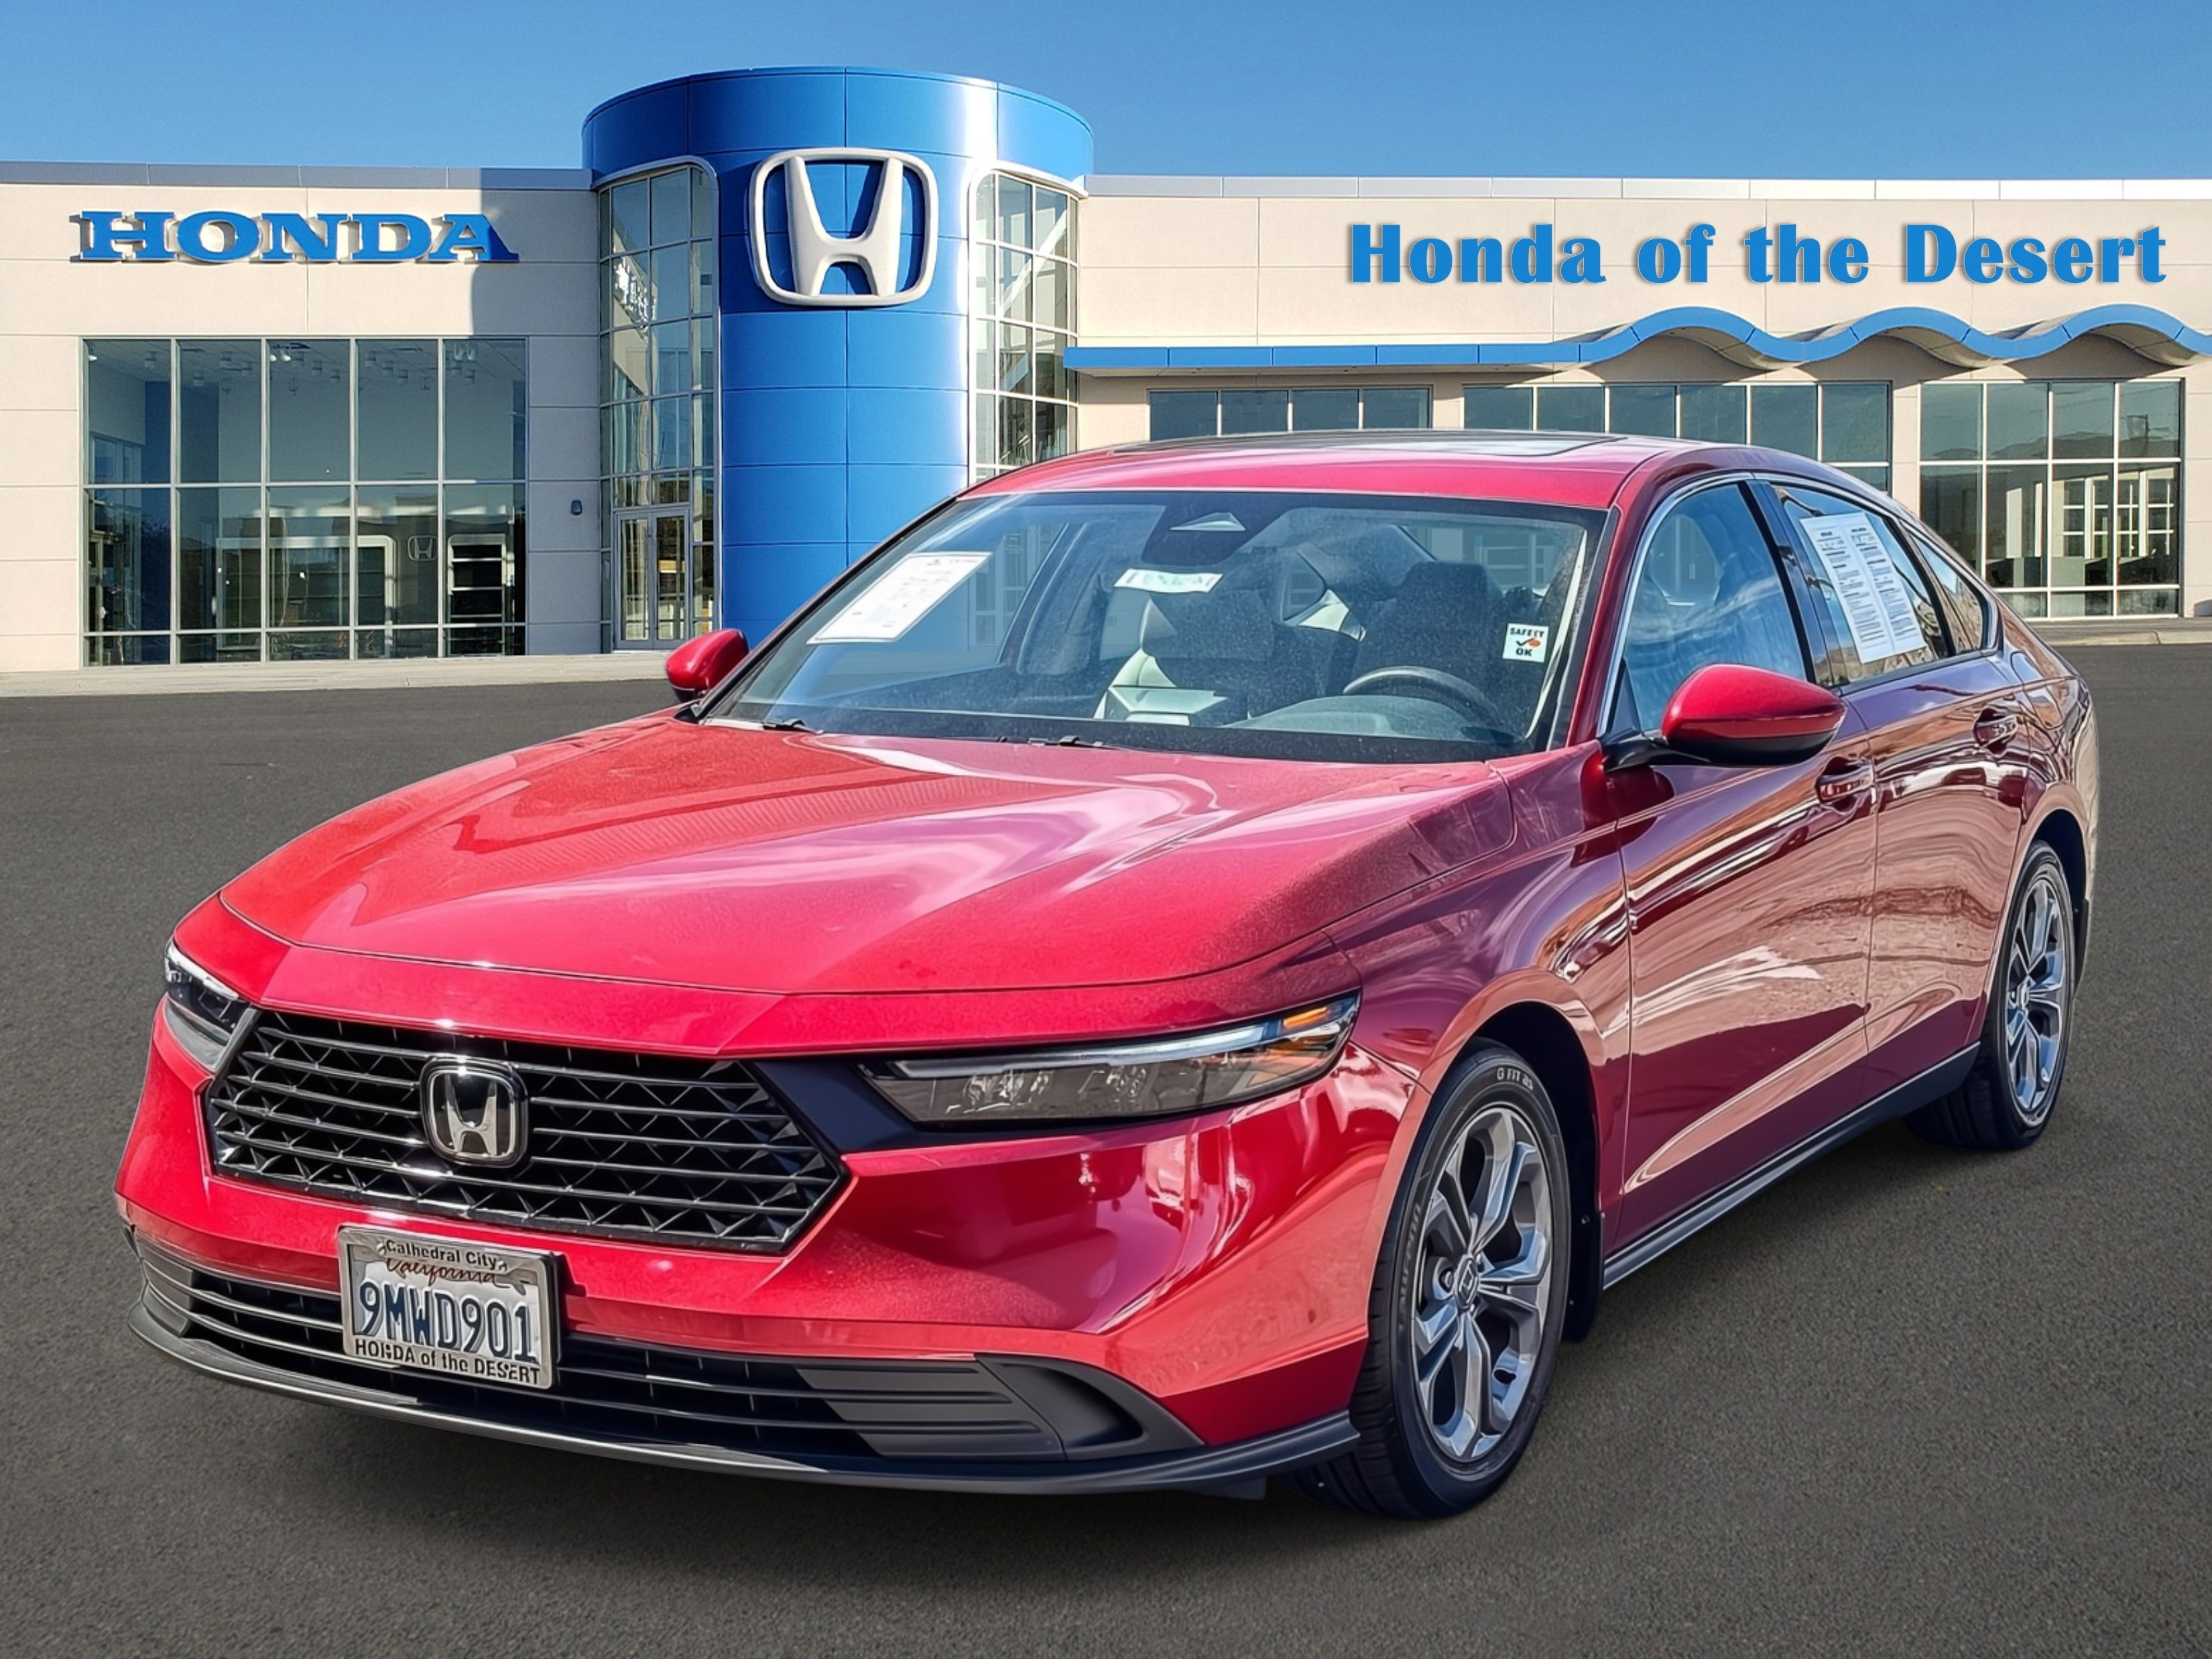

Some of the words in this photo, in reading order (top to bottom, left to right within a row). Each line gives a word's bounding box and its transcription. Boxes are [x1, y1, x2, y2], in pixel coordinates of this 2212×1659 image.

[80, 210, 519, 261] HONDA
[1351, 223, 1607, 284] Honda
[1638, 223, 1716, 284] of
[1743, 223, 1869, 284] the
[1906, 224, 2166, 284] Desert
[1510, 627, 1544, 638] SAFETY
[1516, 648, 1532, 656] OK
[386, 1239, 460, 1263] Cathedral
[466, 1251, 497, 1270] City
[359, 1280, 539, 1365] 9MWD901
[355, 1339, 415, 1363] HONDA
[420, 1349, 436, 1367] of
[442, 1353, 469, 1372] the
[474, 1358, 540, 1385] DESERT
